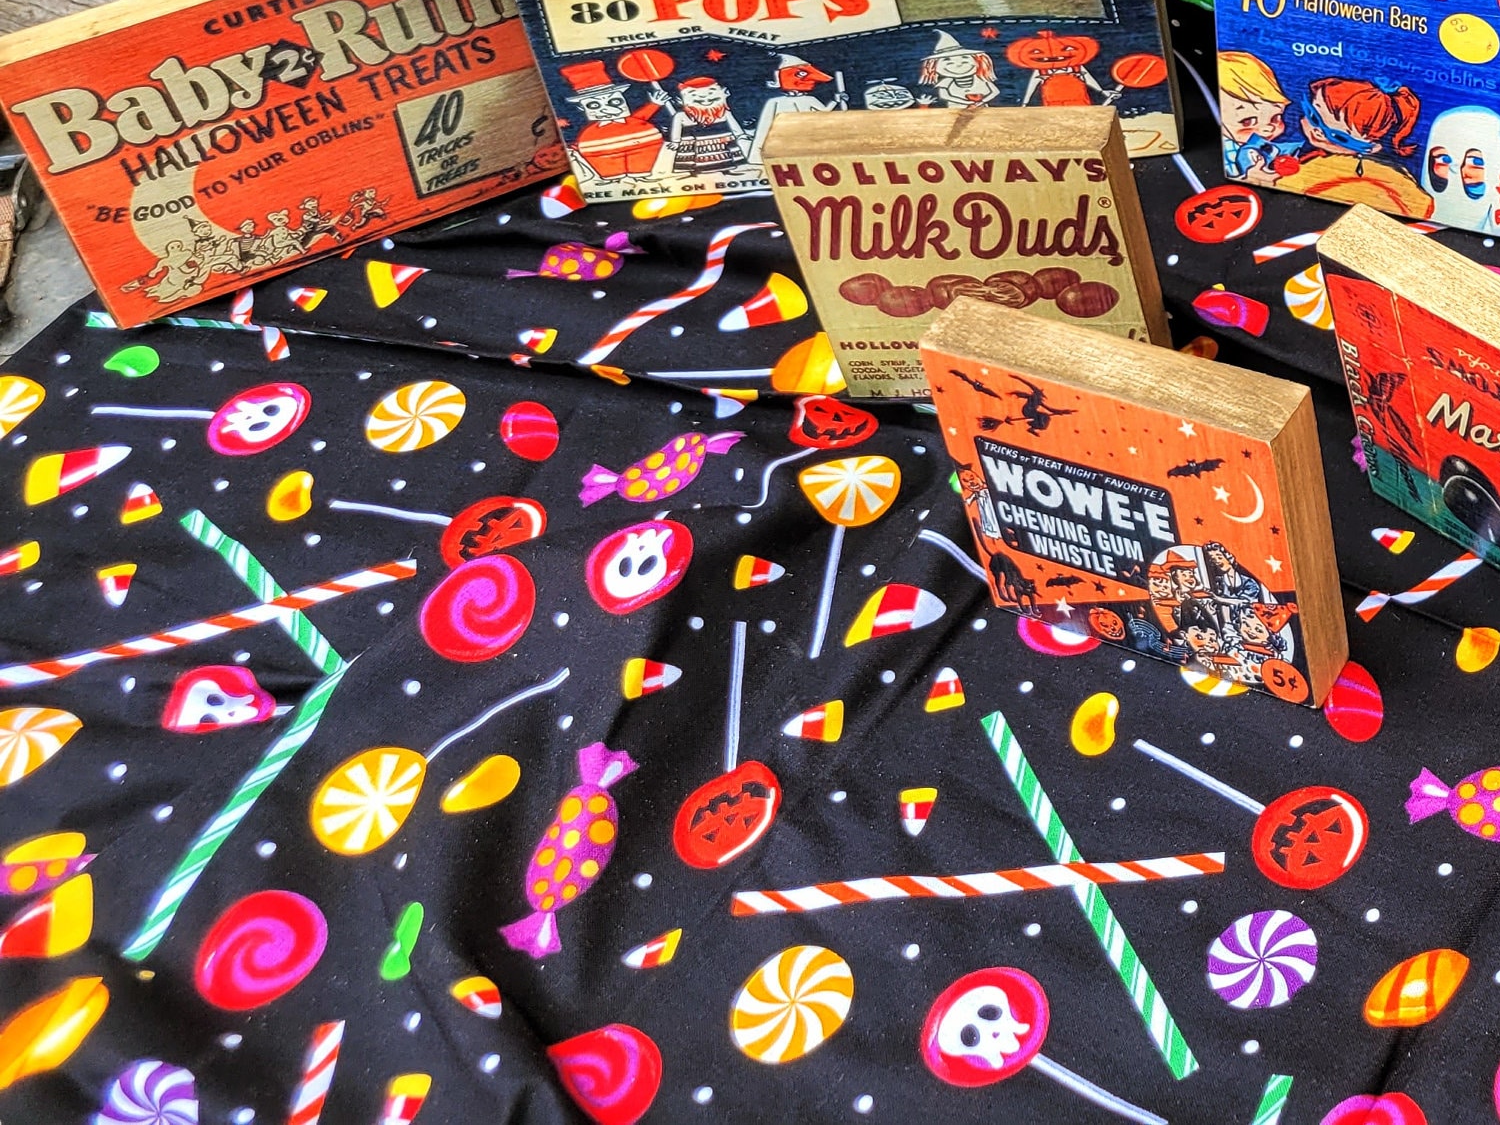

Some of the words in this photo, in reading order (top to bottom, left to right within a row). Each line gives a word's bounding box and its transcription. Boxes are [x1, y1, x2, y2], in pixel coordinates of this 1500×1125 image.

[608, 31, 658, 45] TRICK
[678, 25, 704, 35] OR
[727, 27, 781, 42] TREAT
[1388, 6, 1429, 36] Bars
[1291, 40, 1344, 59] good
[11, 41, 272, 175] Baby
[120, 87, 348, 187] HALLOWEEN
[361, 34, 497, 103] TREATS
[414, 89, 465, 148] 40
[416, 130, 476, 167] TRICKS
[133, 194, 196, 223] GOOD
[197, 180, 228, 199] TO
[229, 151, 288, 185] YOUR
[621, 186, 673, 198] MASK
[681, 183, 706, 192] ON
[715, 178, 769, 190] BOTTO
[771, 157, 1109, 188] HOLLOWAY'S
[793, 192, 960, 263] Milk
[953, 191, 1125, 267] Duds
[1339, 336, 1369, 410] Black
[1019, 455, 1030, 463] or
[1031, 455, 1063, 471] TREAT
[981, 454, 1175, 544] WOWE-E
[997, 500, 1093, 547] CHEWING
[1095, 528, 1145, 563] GUM
[1027, 531, 1118, 577] WHISTLE
[1272, 667, 1298, 690] 5¢
